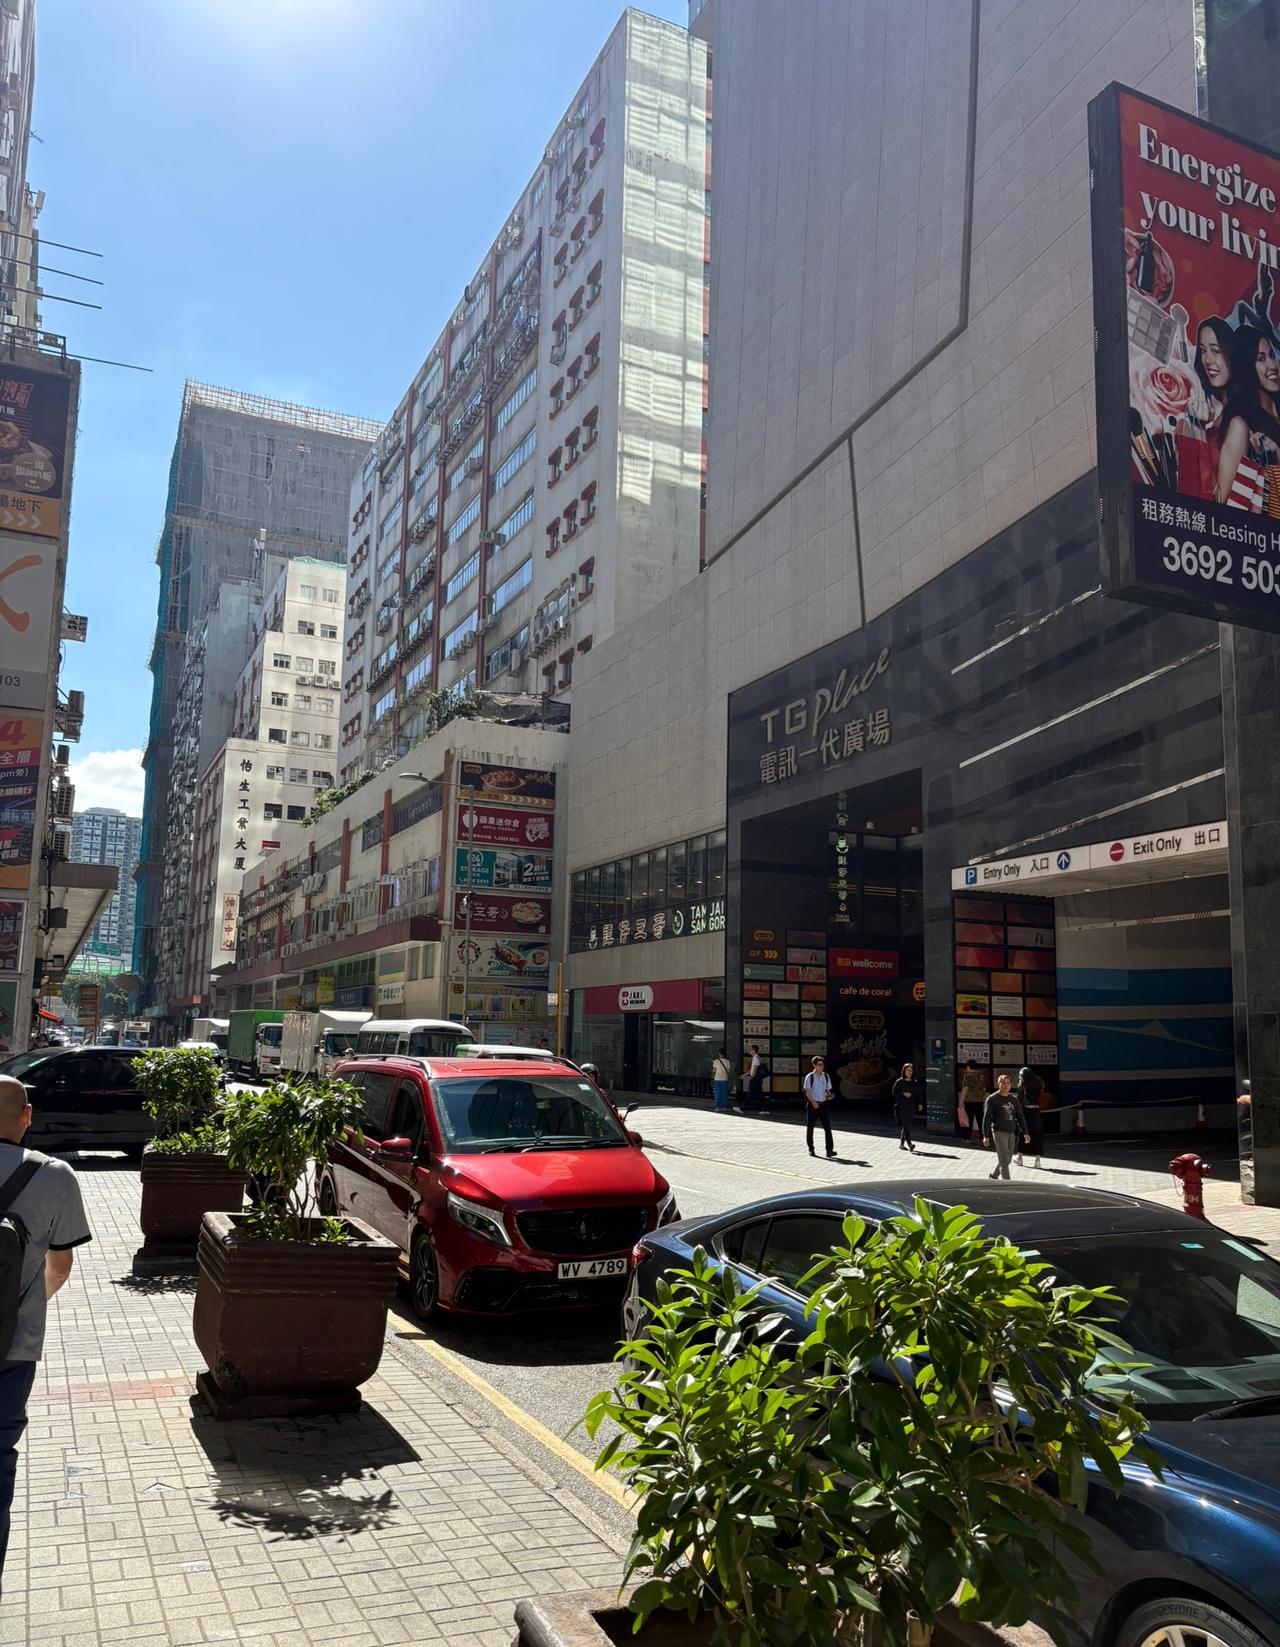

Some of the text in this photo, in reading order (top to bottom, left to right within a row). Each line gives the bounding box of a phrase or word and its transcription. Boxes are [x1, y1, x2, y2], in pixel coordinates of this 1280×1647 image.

[1137, 122, 1276, 213] Energize
[1140, 190, 1215, 242] your
[1142, 498, 1207, 533] 租務熱線
[1211, 516, 1266, 553] Leasing
[1163, 536, 1233, 585] 3692
[812, 647, 890, 737] Place
[760, 708, 891, 783] 電訊一代廣場
[1133, 828, 1220, 855] Exit Only 出口
[461, 865, 489, 875] STRAGE
[984, 867, 1002, 879] Entry
[1004, 863, 1020, 876] Only
[1030, 857, 1049, 872] 入口
[710, 900, 724, 916] JAI
[709, 914, 726, 931] GOR
[852, 959, 893, 969] wellcome
[840, 986, 892, 998] cafe de coral
[562, 1260, 625, 1278] WV 4789
